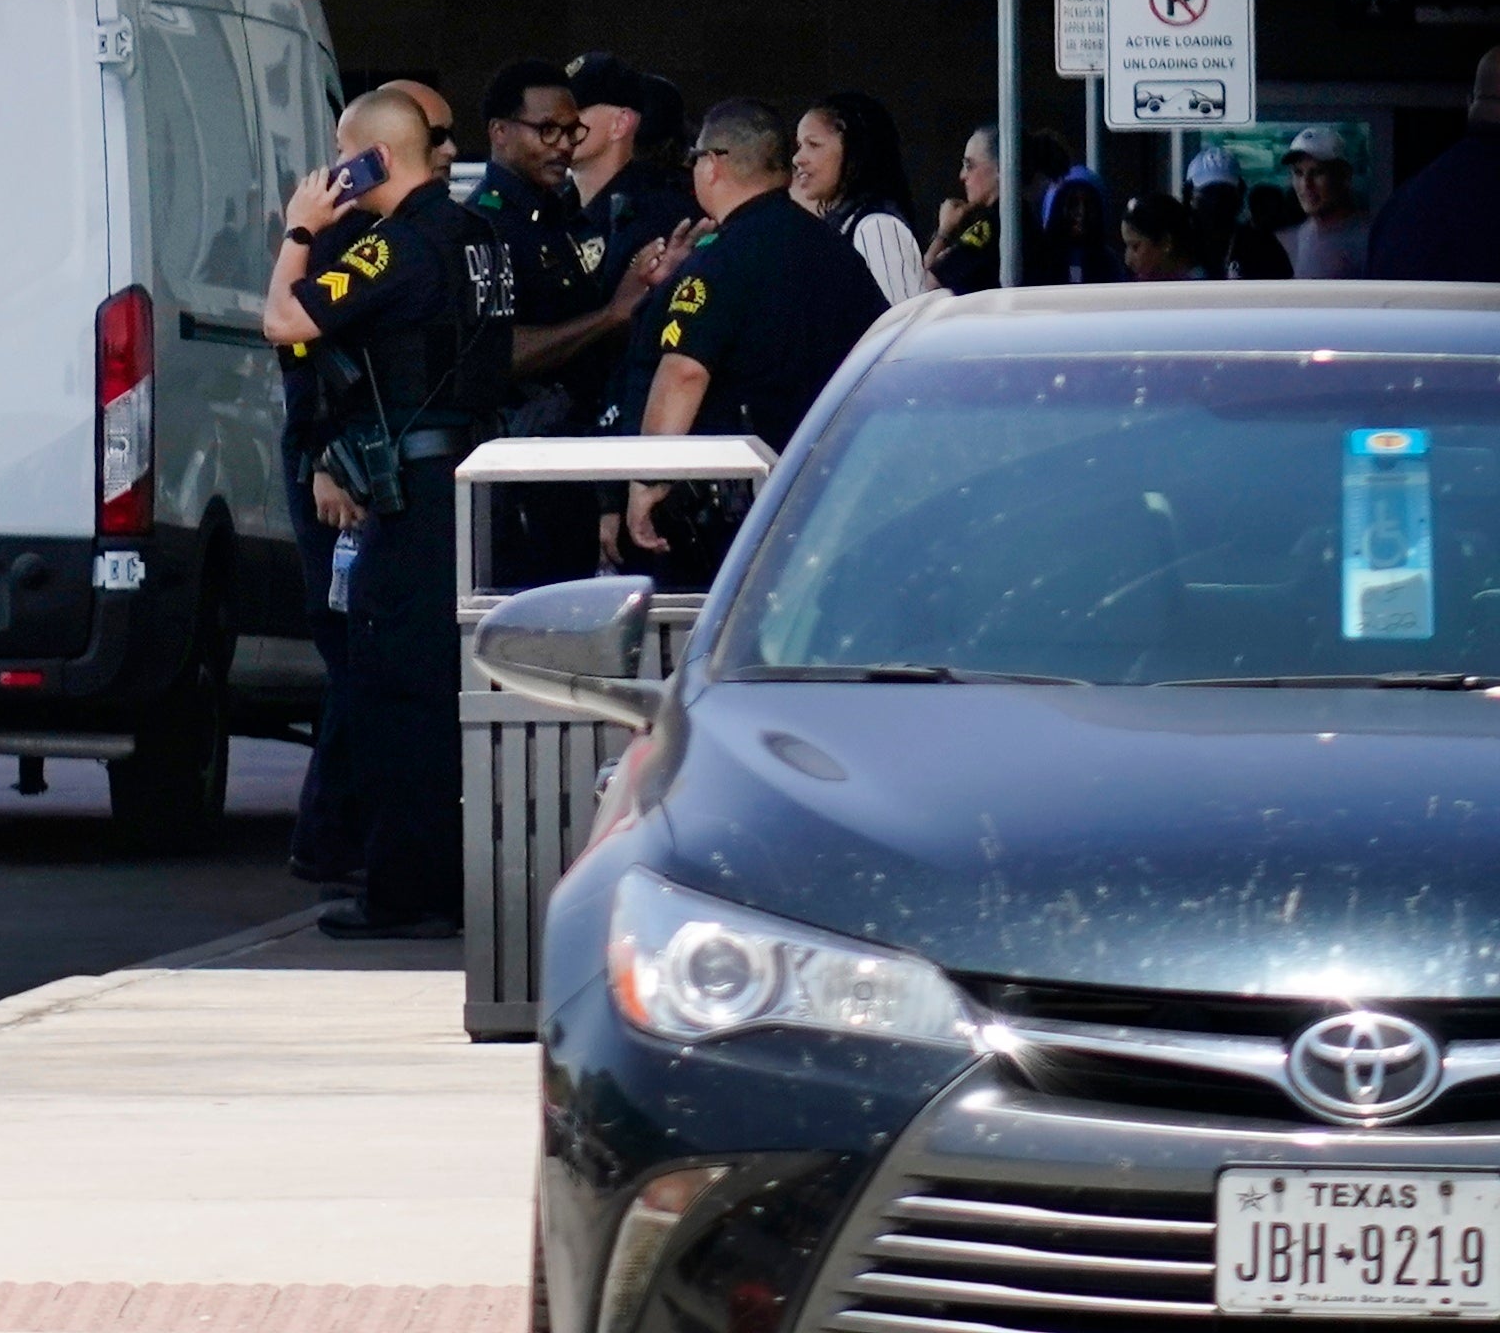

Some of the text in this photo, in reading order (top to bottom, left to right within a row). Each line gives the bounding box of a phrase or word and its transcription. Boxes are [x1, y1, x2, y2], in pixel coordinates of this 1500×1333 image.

[1125, 35, 1232, 47] ACTIVE LOADING
[1123, 57, 1236, 70] UNLOADING ONLY
[1309, 1183, 1418, 1208] TEXAS
